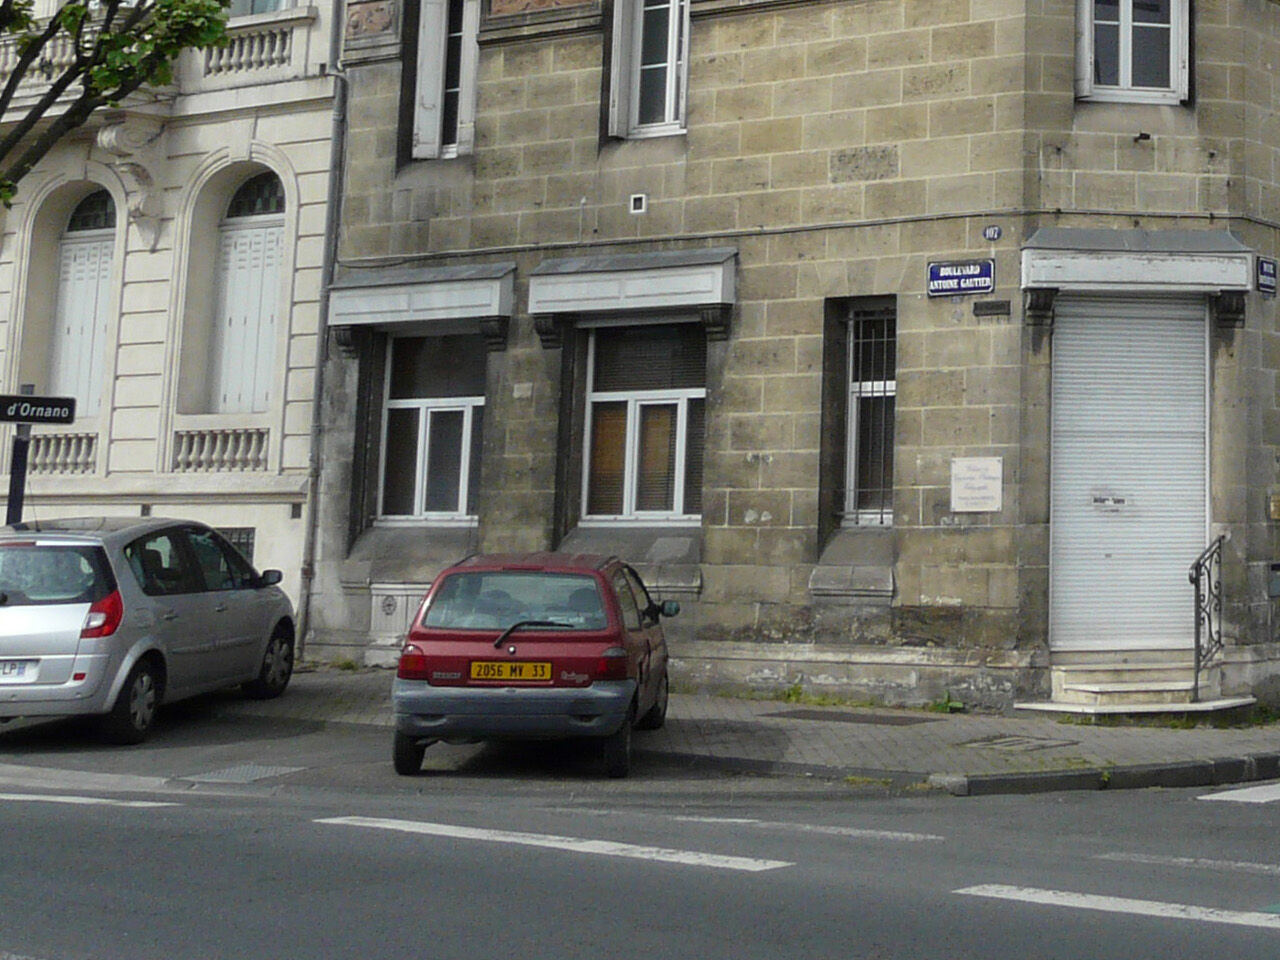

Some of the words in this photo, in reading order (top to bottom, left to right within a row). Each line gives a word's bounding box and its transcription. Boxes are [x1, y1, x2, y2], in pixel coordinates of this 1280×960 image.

[940, 265, 981, 277] BOULEVARD
[930, 279, 959, 290] ANTOINE
[960, 277, 991, 288] GAUTIER
[7, 402, 69, 418] d'Ornano
[476, 663, 504, 678] 2056
[531, 663, 546, 678] 33
